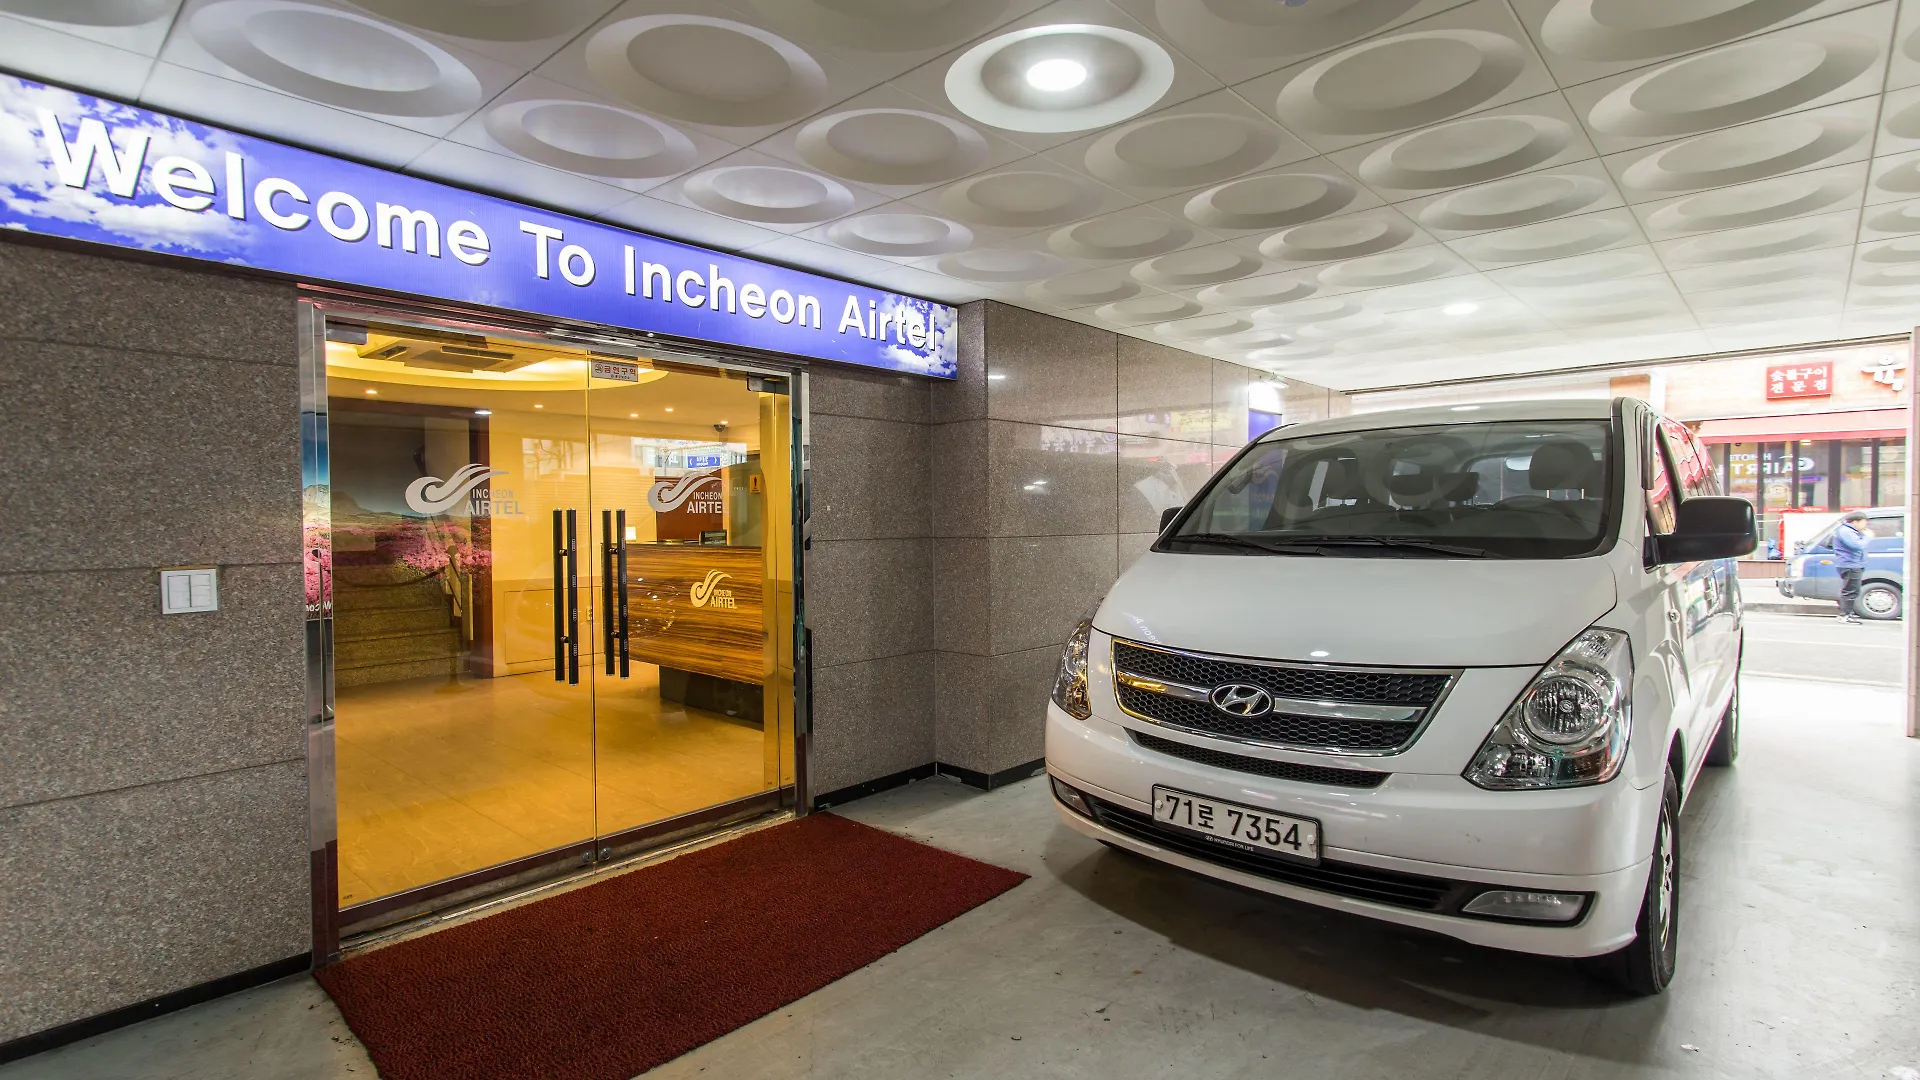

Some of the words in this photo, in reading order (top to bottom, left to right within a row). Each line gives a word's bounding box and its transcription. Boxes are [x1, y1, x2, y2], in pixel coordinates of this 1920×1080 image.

[35, 106, 491, 266] Welcome
[519, 219, 597, 288] To
[624, 244, 823, 331] Incheon
[838, 293, 938, 352] Airtel
[693, 491, 724, 500] INCHEON
[464, 499, 524, 516] AIRTEL
[710, 596, 738, 609] AIRTEL
[1165, 794, 1214, 829] 71로
[1227, 808, 1301, 851] 7354
